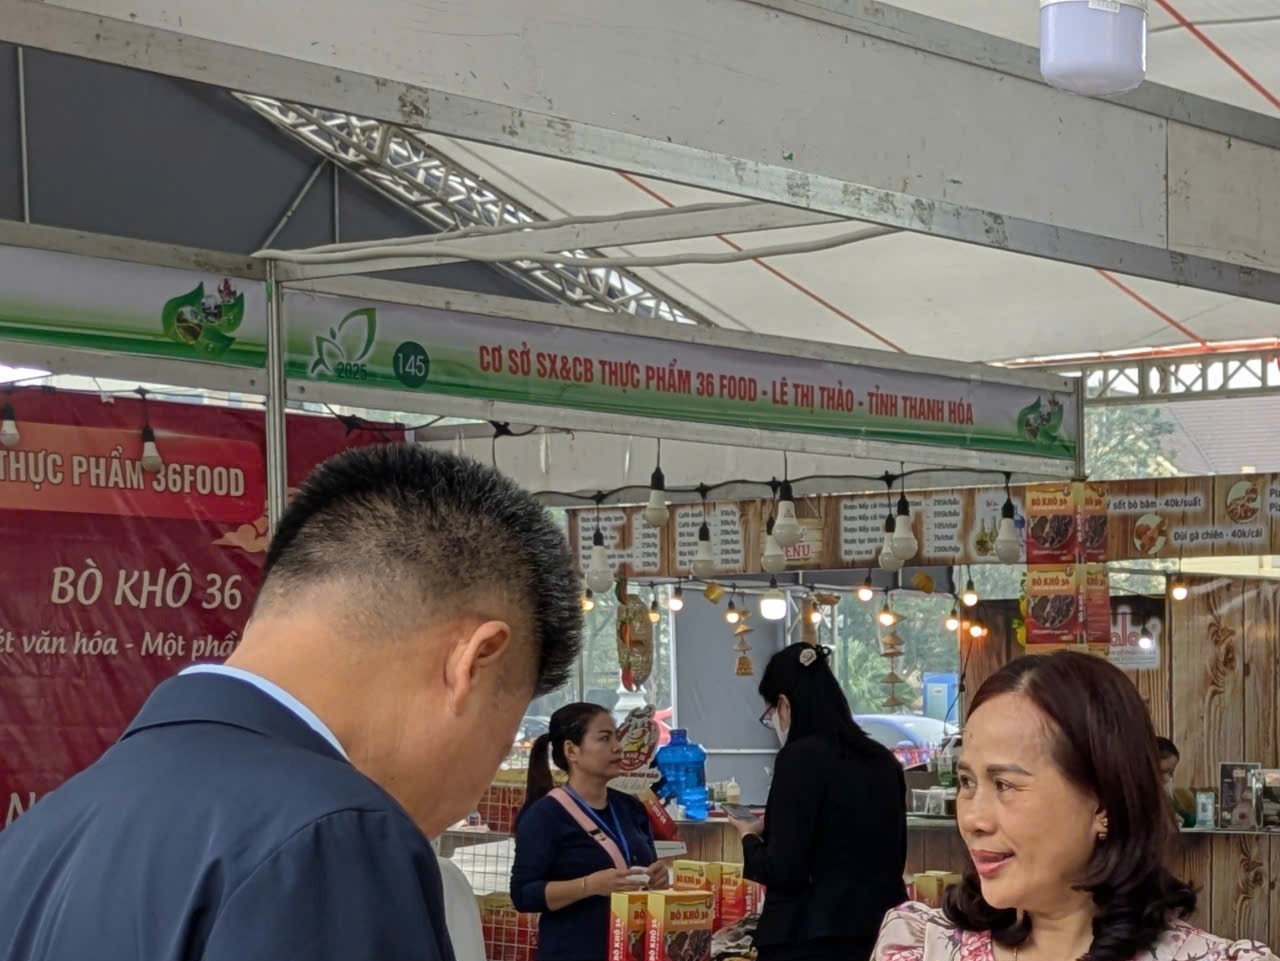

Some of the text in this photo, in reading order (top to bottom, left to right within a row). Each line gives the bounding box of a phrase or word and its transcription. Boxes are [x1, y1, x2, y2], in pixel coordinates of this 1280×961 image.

[337, 362, 367, 380] 2025
[398, 353, 425, 377] 145
[480, 345, 503, 372] CƠ
[509, 342, 531, 376] SỞ
[537, 352, 594, 383] SX&CB
[600, 360, 640, 393] THỰC
[645, 359, 691, 394] PHẨM
[696, 372, 714, 398] 36
[720, 375, 757, 401] FOOD
[772, 377, 788, 406] LÊ
[792, 384, 814, 414] THỊ
[819, 380, 854, 412] THẢO
[867, 385, 898, 417] TỈNH
[902, 395, 944, 422] THANH
[949, 396, 974, 425] HÓA
[72, 446, 144, 489] PHẨM
[152, 463, 245, 497] 36FOOD
[780, 544, 810, 558] ENU
[51, 558, 242, 610] BÒ KHÔ 36
[22, 630, 66, 654] văn
[73, 631, 118, 655] hóa
[141, 631, 186, 660] Một
[192, 631, 241, 661] phầ
